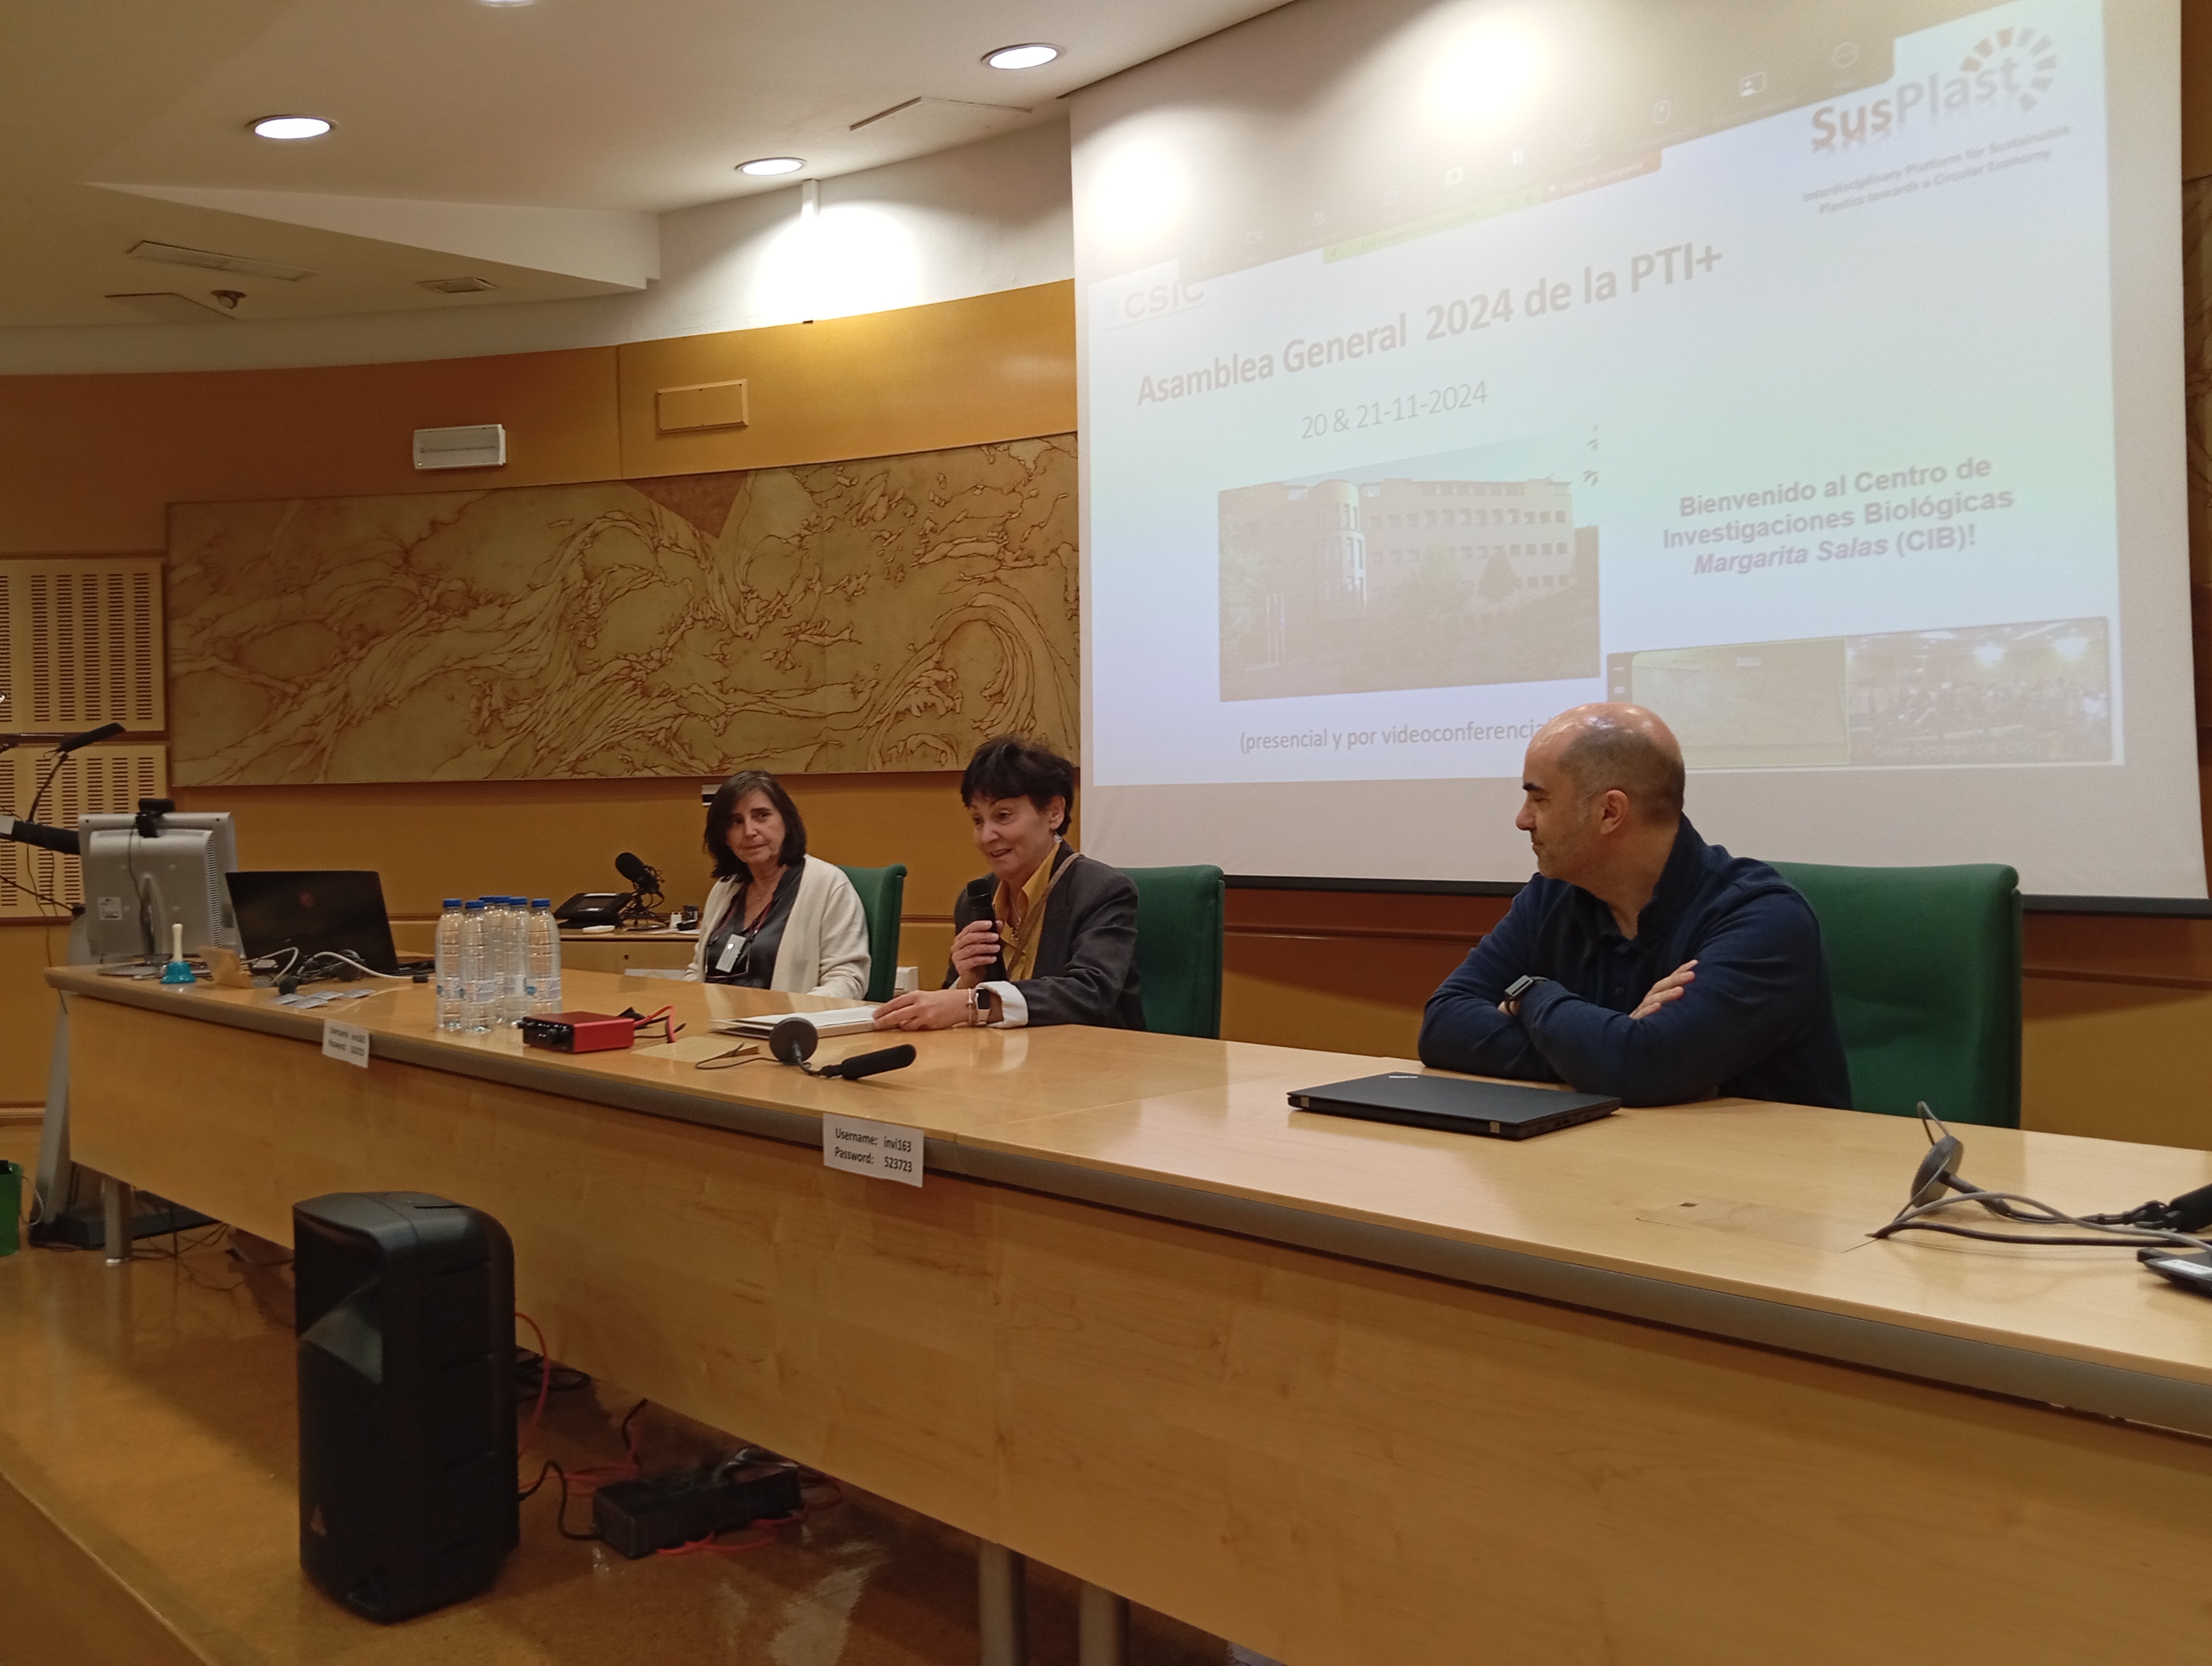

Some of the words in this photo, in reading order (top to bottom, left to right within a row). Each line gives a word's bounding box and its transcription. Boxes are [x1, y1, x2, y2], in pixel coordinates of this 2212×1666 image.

[1811, 57, 2021, 148] SusPlast
[1137, 353, 1274, 406] Asamblea
[1283, 312, 1407, 373] General
[1426, 288, 1514, 341] 2024
[1524, 277, 1571, 317] de
[1583, 265, 1617, 304] la
[1631, 242, 1723, 293] PTI+
[1301, 413, 1327, 440] 20
[1333, 408, 1351, 432] &
[1357, 380, 1488, 429] 21-11-2024
[1680, 481, 1816, 516] Bienvenido
[1824, 474, 1846, 497] al
[1854, 465, 1948, 493] Centro
[1956, 456, 1992, 479] de
[1663, 510, 1855, 548] Investigaciones
[1864, 490, 2016, 524] Biológicas
[1694, 545, 1809, 575] Margarita
[1817, 537, 1889, 561] Salas
[1896, 523, 1976, 558] (CIB)!
[1240, 728, 1327, 754] (presencial
[1332, 733, 1342, 751] y
[1347, 731, 1378, 751] por
[834, 1146, 874, 1164] Password:
[884, 1156, 912, 1172] 523723
[835, 1127, 878, 1145] Username:
[884, 1136, 912, 1153] invi163
